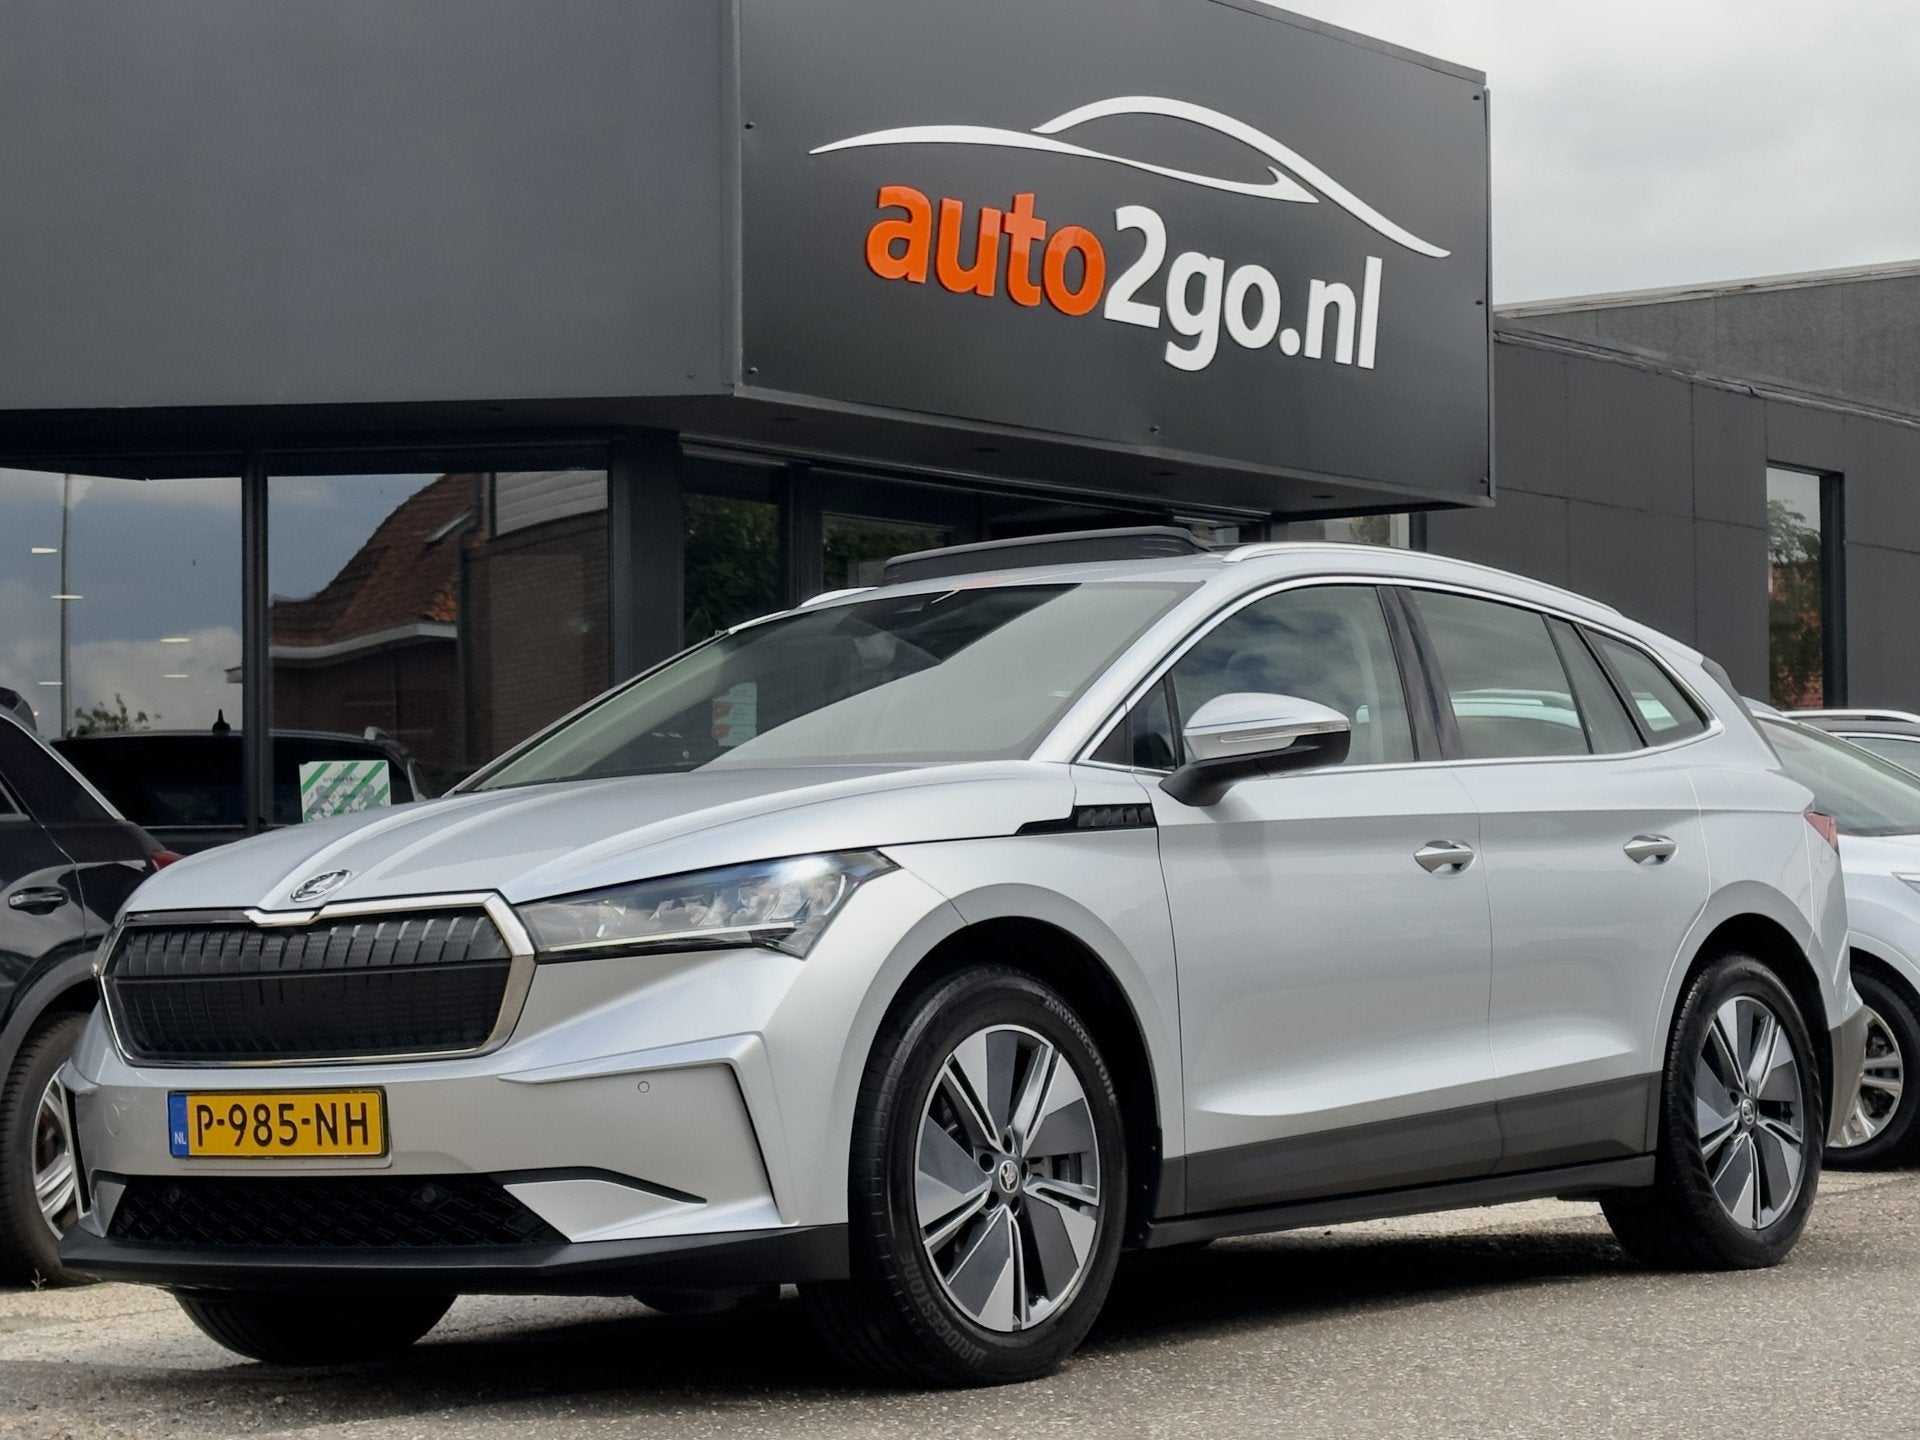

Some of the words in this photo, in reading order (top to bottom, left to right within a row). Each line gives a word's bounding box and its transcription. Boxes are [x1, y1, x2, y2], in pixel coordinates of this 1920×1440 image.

[865, 185, 1383, 371] auto2go.nl
[174, 1131, 187, 1145] NL
[196, 1102, 369, 1148] P-985-NH
[899, 1250, 989, 1369] BRIDGESTONE
